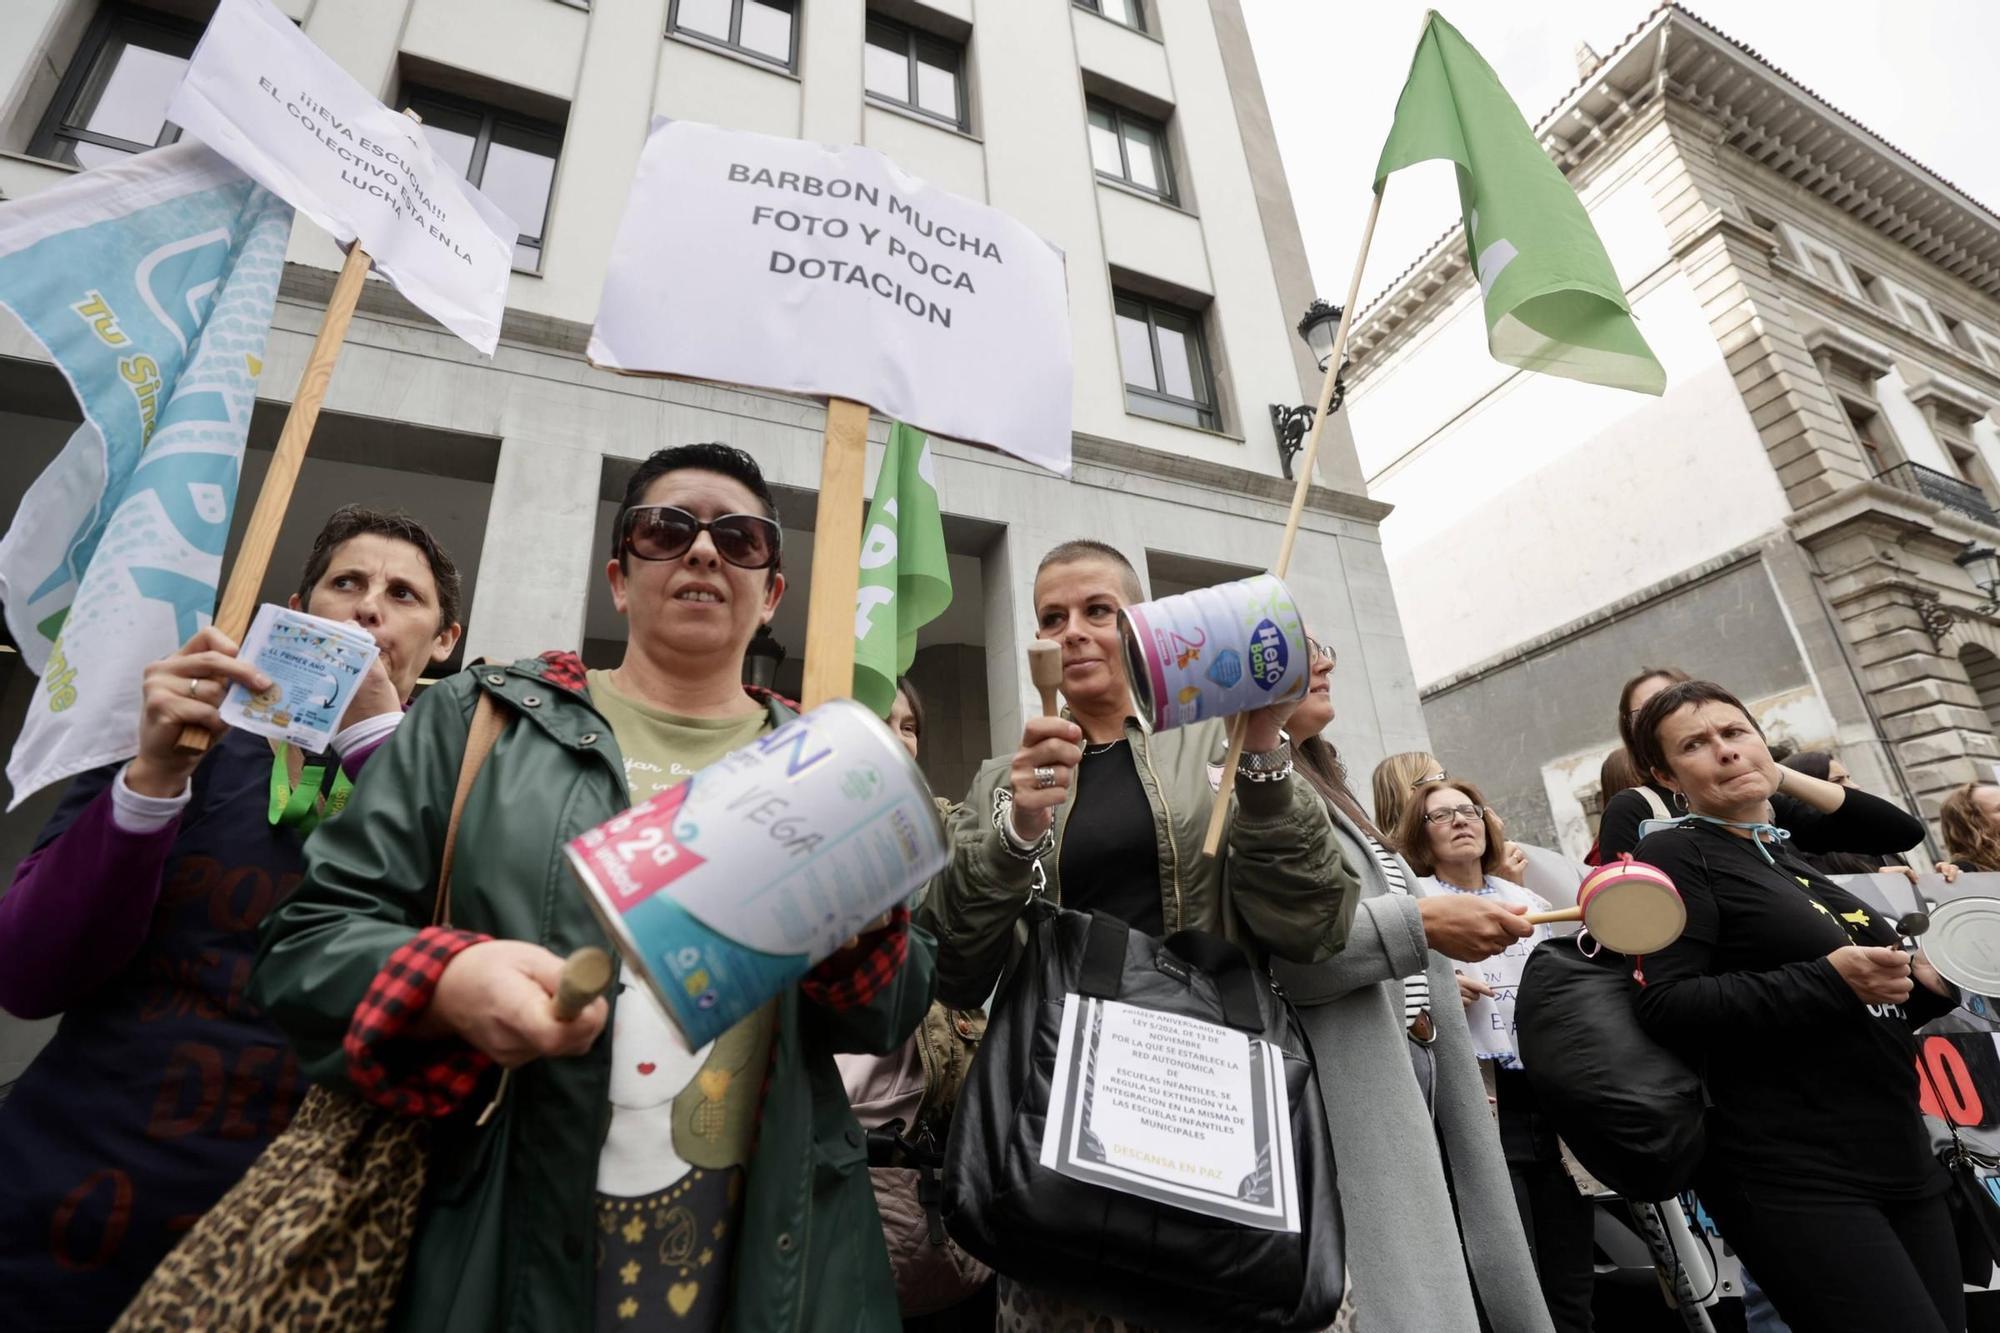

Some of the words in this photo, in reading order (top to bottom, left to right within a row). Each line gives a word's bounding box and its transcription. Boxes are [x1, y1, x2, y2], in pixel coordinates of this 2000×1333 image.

[259, 76, 281, 103] EL
[286, 102, 398, 186] COLECTIVO
[400, 186, 425, 228] ESTA
[429, 224, 451, 247] EN
[454, 244, 473, 265] LA
[359, 137, 447, 222] ESCUCHA!!!
[341, 169, 402, 220] LUCHA
[727, 163, 879, 207] BARBON
[888, 194, 1004, 265] MUCHA
[751, 205, 849, 240] FOTO
[859, 221, 881, 247] Y
[887, 237, 977, 294] POCA
[768, 250, 953, 329] DOTACION
[72, 291, 130, 346] Tu
[1169, 626, 1206, 654] 2
[1258, 626, 1284, 684] Hero
[1250, 642, 1267, 680] Baby
[726, 786, 826, 858] VEGA
[1132, 1018, 1148, 1028] LEY
[1182, 1029, 1194, 1038] DE
[1197, 1031, 1206, 1041] 13
[1208, 1034, 1219, 1044] DE
[1149, 1032, 1201, 1050] NOVIEMBRE
[1156, 1015, 1214, 1033] ANIVERSARIO
[1112, 1033, 1129, 1045] POR
[1132, 1038, 1144, 1048] LA
[1145, 1041, 1164, 1053] QUE
[1166, 1045, 1176, 1056] SE
[1178, 1048, 1225, 1067] ESTABLECE
[1227, 1060, 1239, 1071] LA
[1132, 1050, 1150, 1060] RED
[1152, 1054, 1215, 1075] AUTONOMICA
[1116, 1067, 1161, 1085] ESCUELAS
[1220, 1092, 1232, 1100] SE
[1167, 1069, 1178, 1078] DE
[1110, 1077, 1146, 1092] REGULA
[1148, 1086, 1160, 1095] SU
[1226, 1104, 1238, 1113] LA
[1112, 1099, 1130, 1110] LAS
[1132, 1103, 1177, 1123] ESCUELAS
[1179, 1117, 1235, 1135] INFANTILES
[1140, 1117, 1206, 1140] MUNICIPALES
[1169, 1103, 1182, 1112] EN
[1184, 1105, 1197, 1115] LA
[1198, 1110, 1231, 1123] MISMA
[1233, 1116, 1246, 1126] DE
[1113, 1143, 1176, 1170] DESCANSA
[1179, 1162, 1197, 1175] EN
[1200, 1166, 1223, 1180] PAZ
